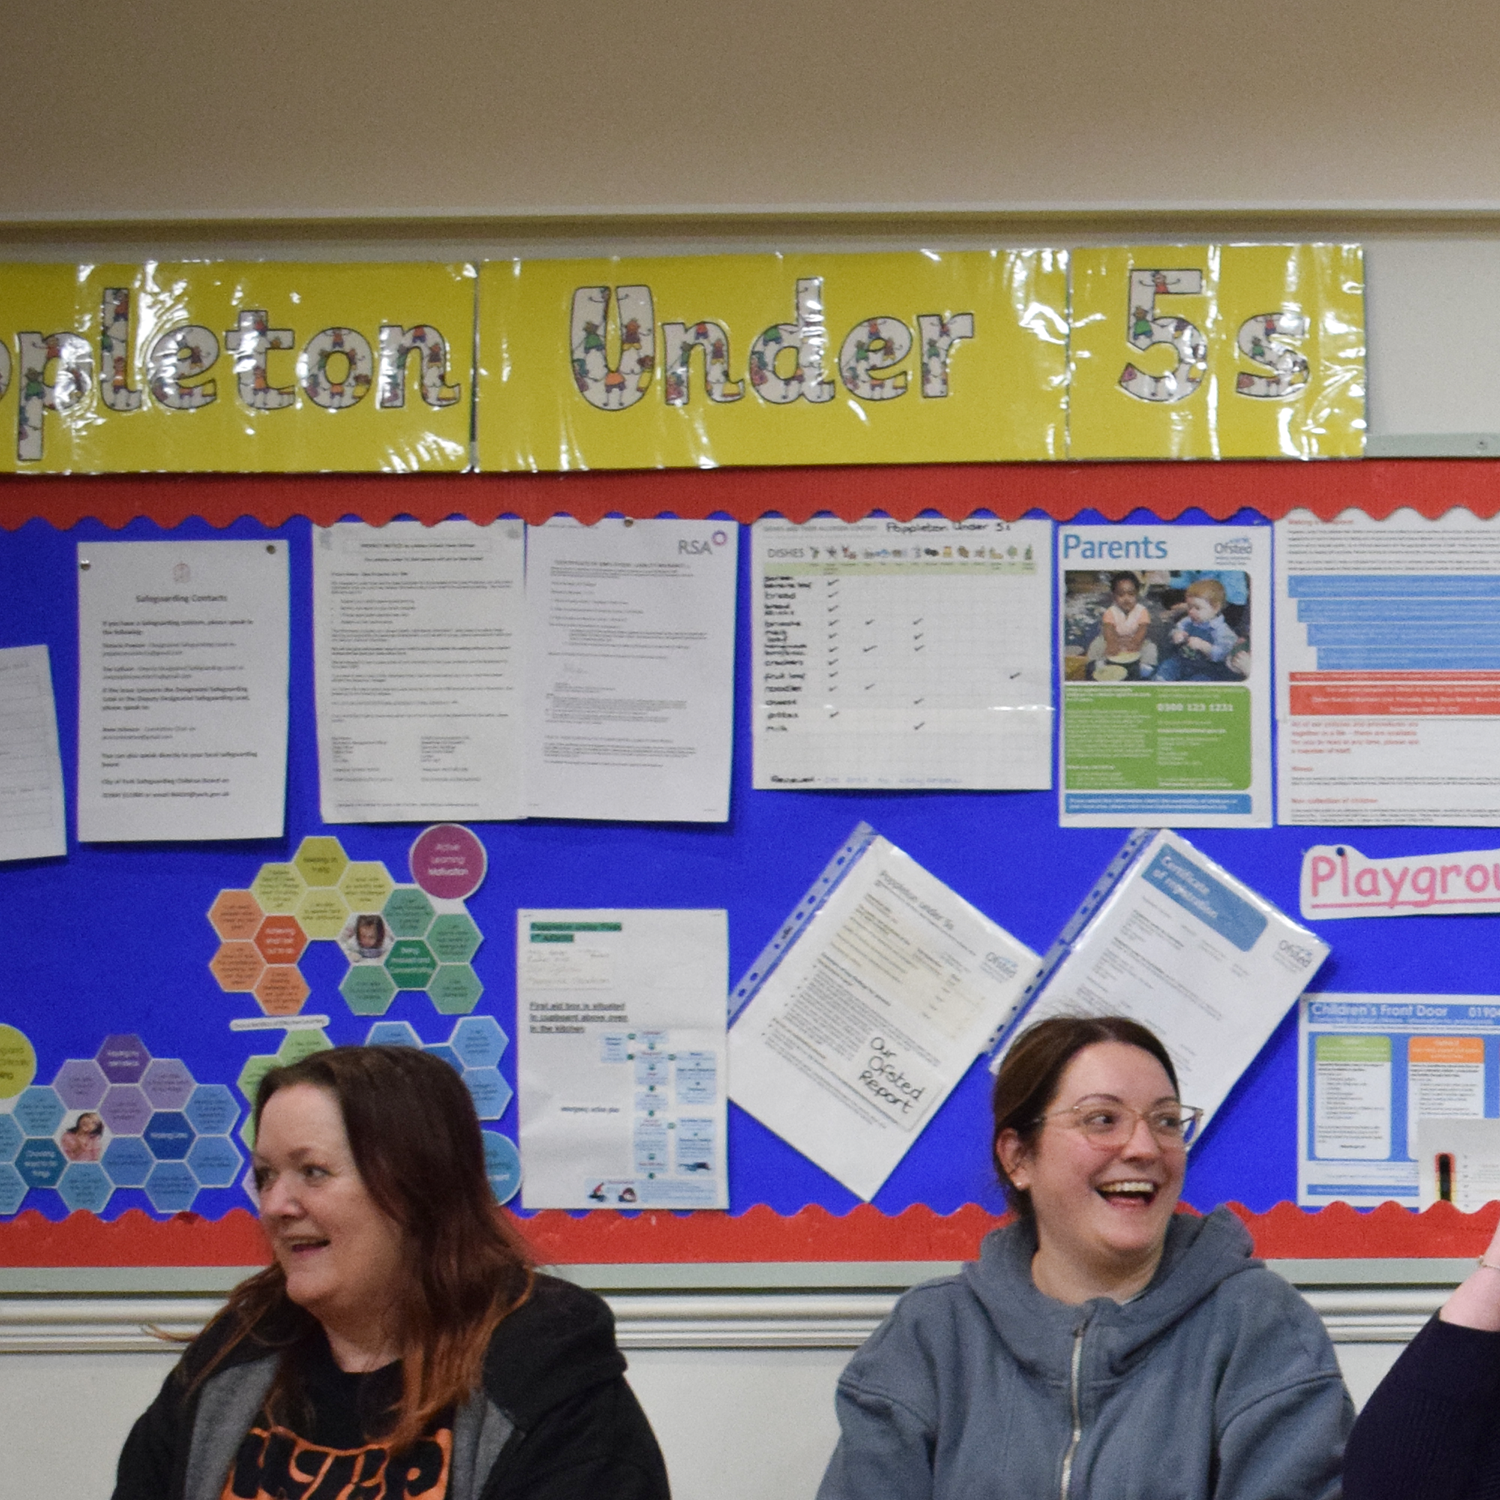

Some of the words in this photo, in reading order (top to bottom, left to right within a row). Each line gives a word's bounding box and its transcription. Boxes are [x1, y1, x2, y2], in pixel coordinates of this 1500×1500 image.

[0, 287, 462, 461] pleton
[569, 277, 975, 411] Under
[1118, 268, 1311, 402] 5s
[885, 522, 947, 534] Poppleton
[677, 539, 713, 555] RSA
[1063, 534, 1168, 560] Parents
[1214, 542, 1253, 555] Ofsted
[1380, 1004, 1413, 1016] Front
[1416, 1005, 1448, 1017] Door
[870, 1036, 897, 1058] Our
[868, 1055, 926, 1101] Ofsted
[858, 1069, 914, 1114] Report
